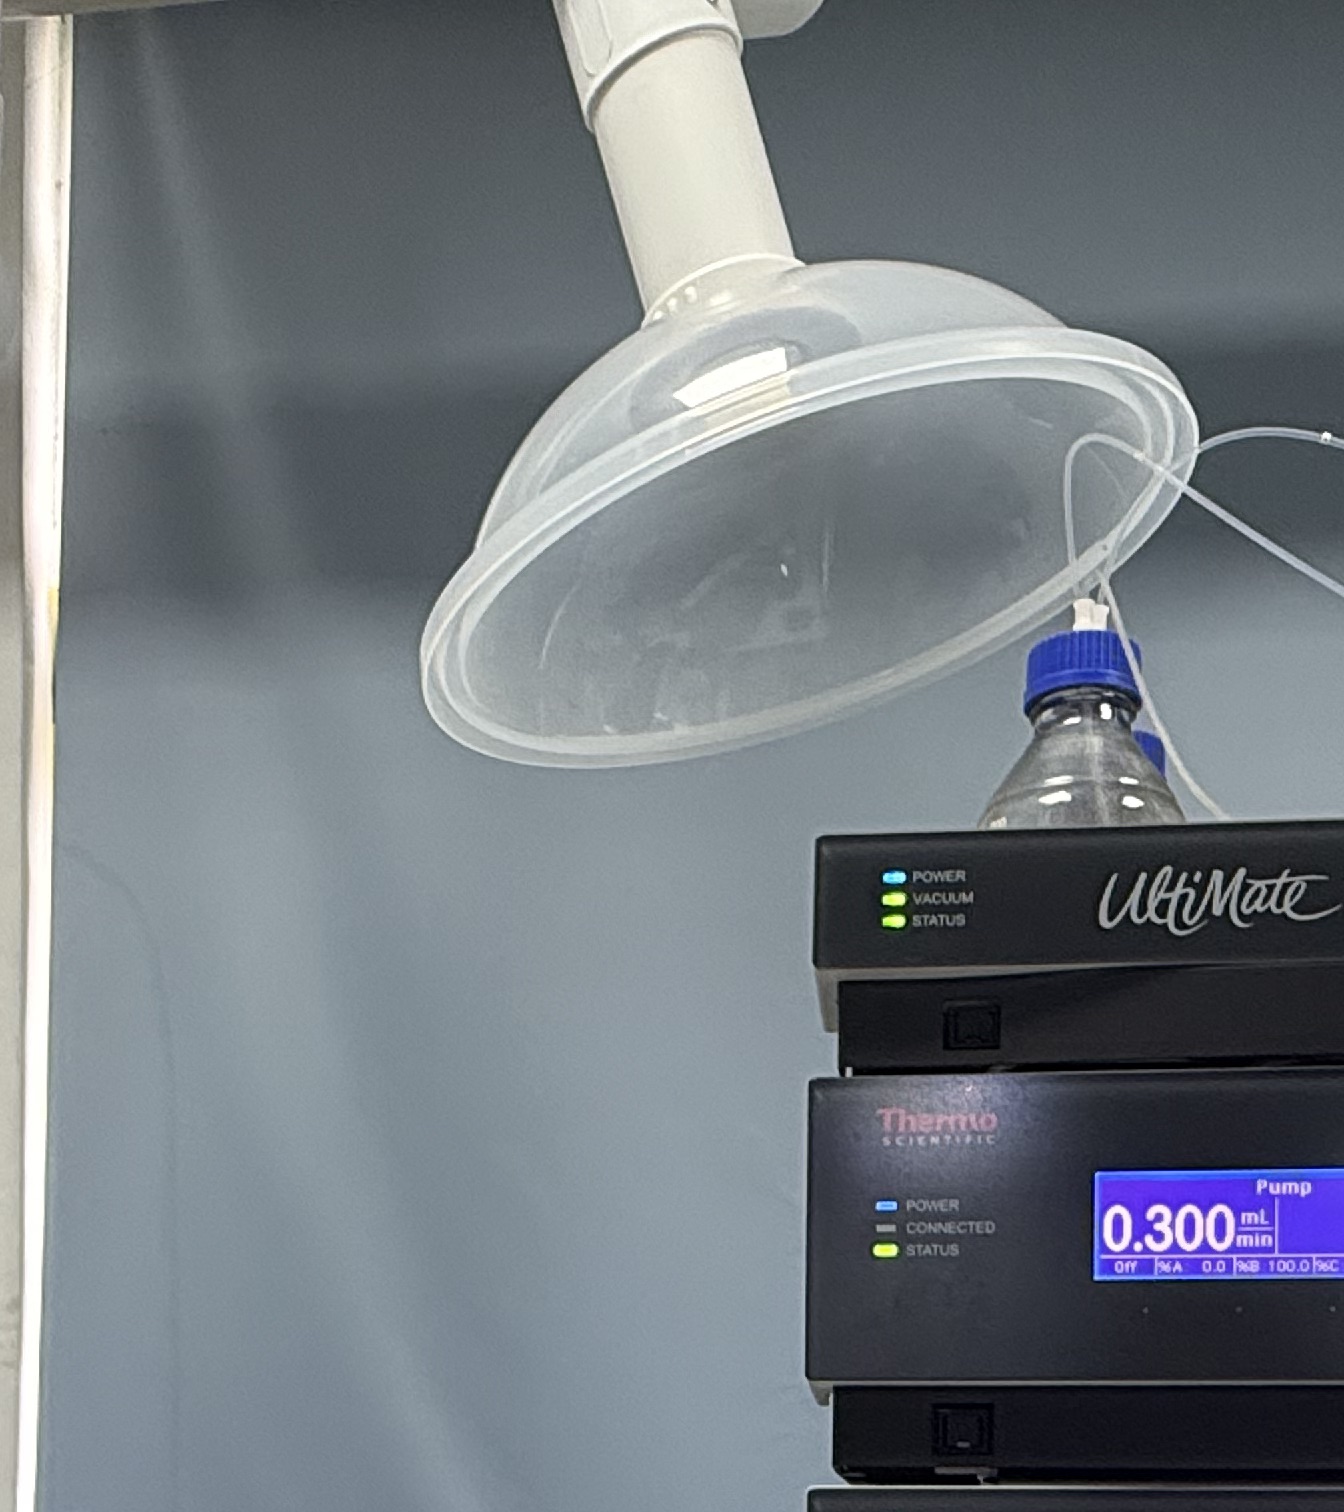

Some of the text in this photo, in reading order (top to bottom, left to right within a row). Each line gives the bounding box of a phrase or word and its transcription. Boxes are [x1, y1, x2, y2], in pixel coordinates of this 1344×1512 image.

[912, 870, 966, 883] POWER
[912, 891, 974, 905] VACUUM
[1098, 865, 1343, 936] UltiMate
[912, 914, 966, 927] STATUS
[876, 1108, 998, 1133] Thermo
[882, 1134, 996, 1146] SCIENTIFIC
[1256, 1179, 1312, 1196] Pump
[907, 1200, 959, 1212] POWER
[907, 1221, 996, 1234] CONNECTED
[1103, 1204, 1235, 1252] 0.300
[1236, 1233, 1273, 1248] min
[907, 1244, 960, 1256] STATUS
[1202, 1259, 1226, 1273] 0.0
[1268, 1259, 1310, 1273] 100.0
